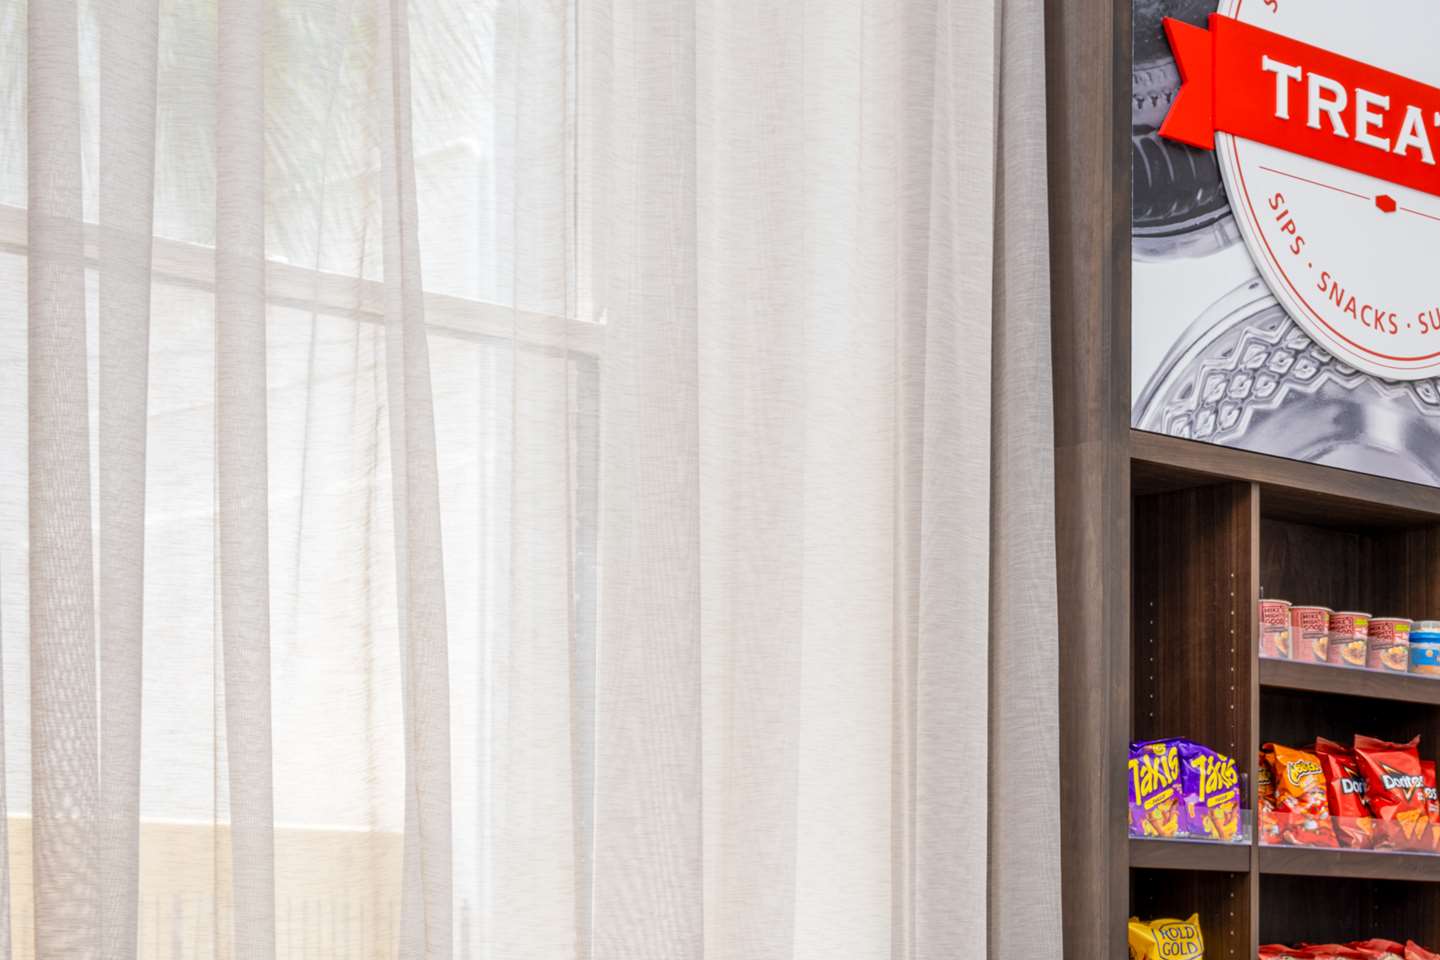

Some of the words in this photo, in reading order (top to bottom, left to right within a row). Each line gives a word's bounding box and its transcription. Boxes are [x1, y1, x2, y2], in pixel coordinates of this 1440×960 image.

[1268, 192, 1305, 256] SIPS
[1317, 271, 1398, 335] SNACKS
[1128, 747, 1178, 806] Takis
[1191, 753, 1238, 802] Takis
[1160, 926, 1195, 941] ROLD
[1162, 942, 1198, 956] GOLD
